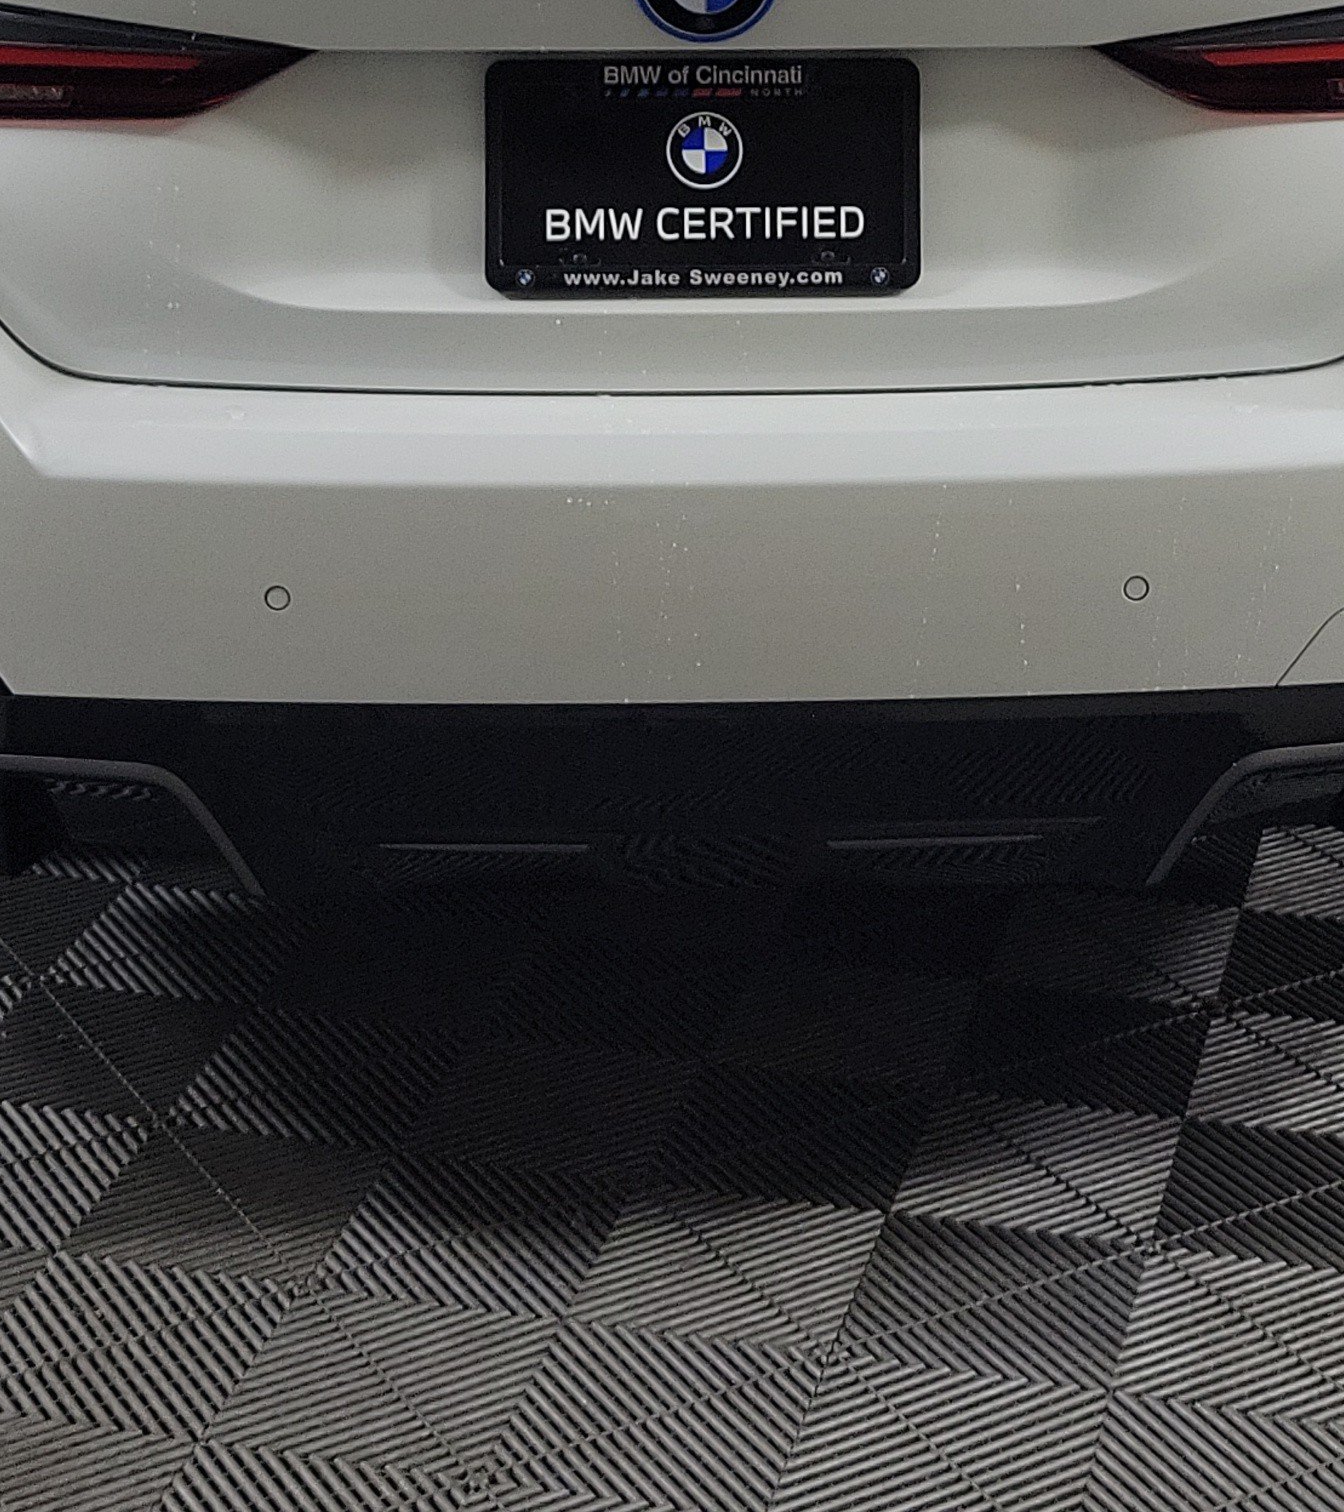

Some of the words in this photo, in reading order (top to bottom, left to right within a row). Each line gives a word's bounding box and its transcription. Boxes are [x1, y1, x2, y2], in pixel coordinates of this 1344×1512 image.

[603, 65, 661, 85] BMW
[668, 65, 690, 85] of
[695, 65, 803, 85] Cincinnati
[677, 116, 732, 138] BMW
[546, 209, 643, 242] BMW
[657, 206, 865, 241] CERTIFIED
[564, 270, 680, 286] www.Jake
[689, 269, 843, 287] Sweeney.com
